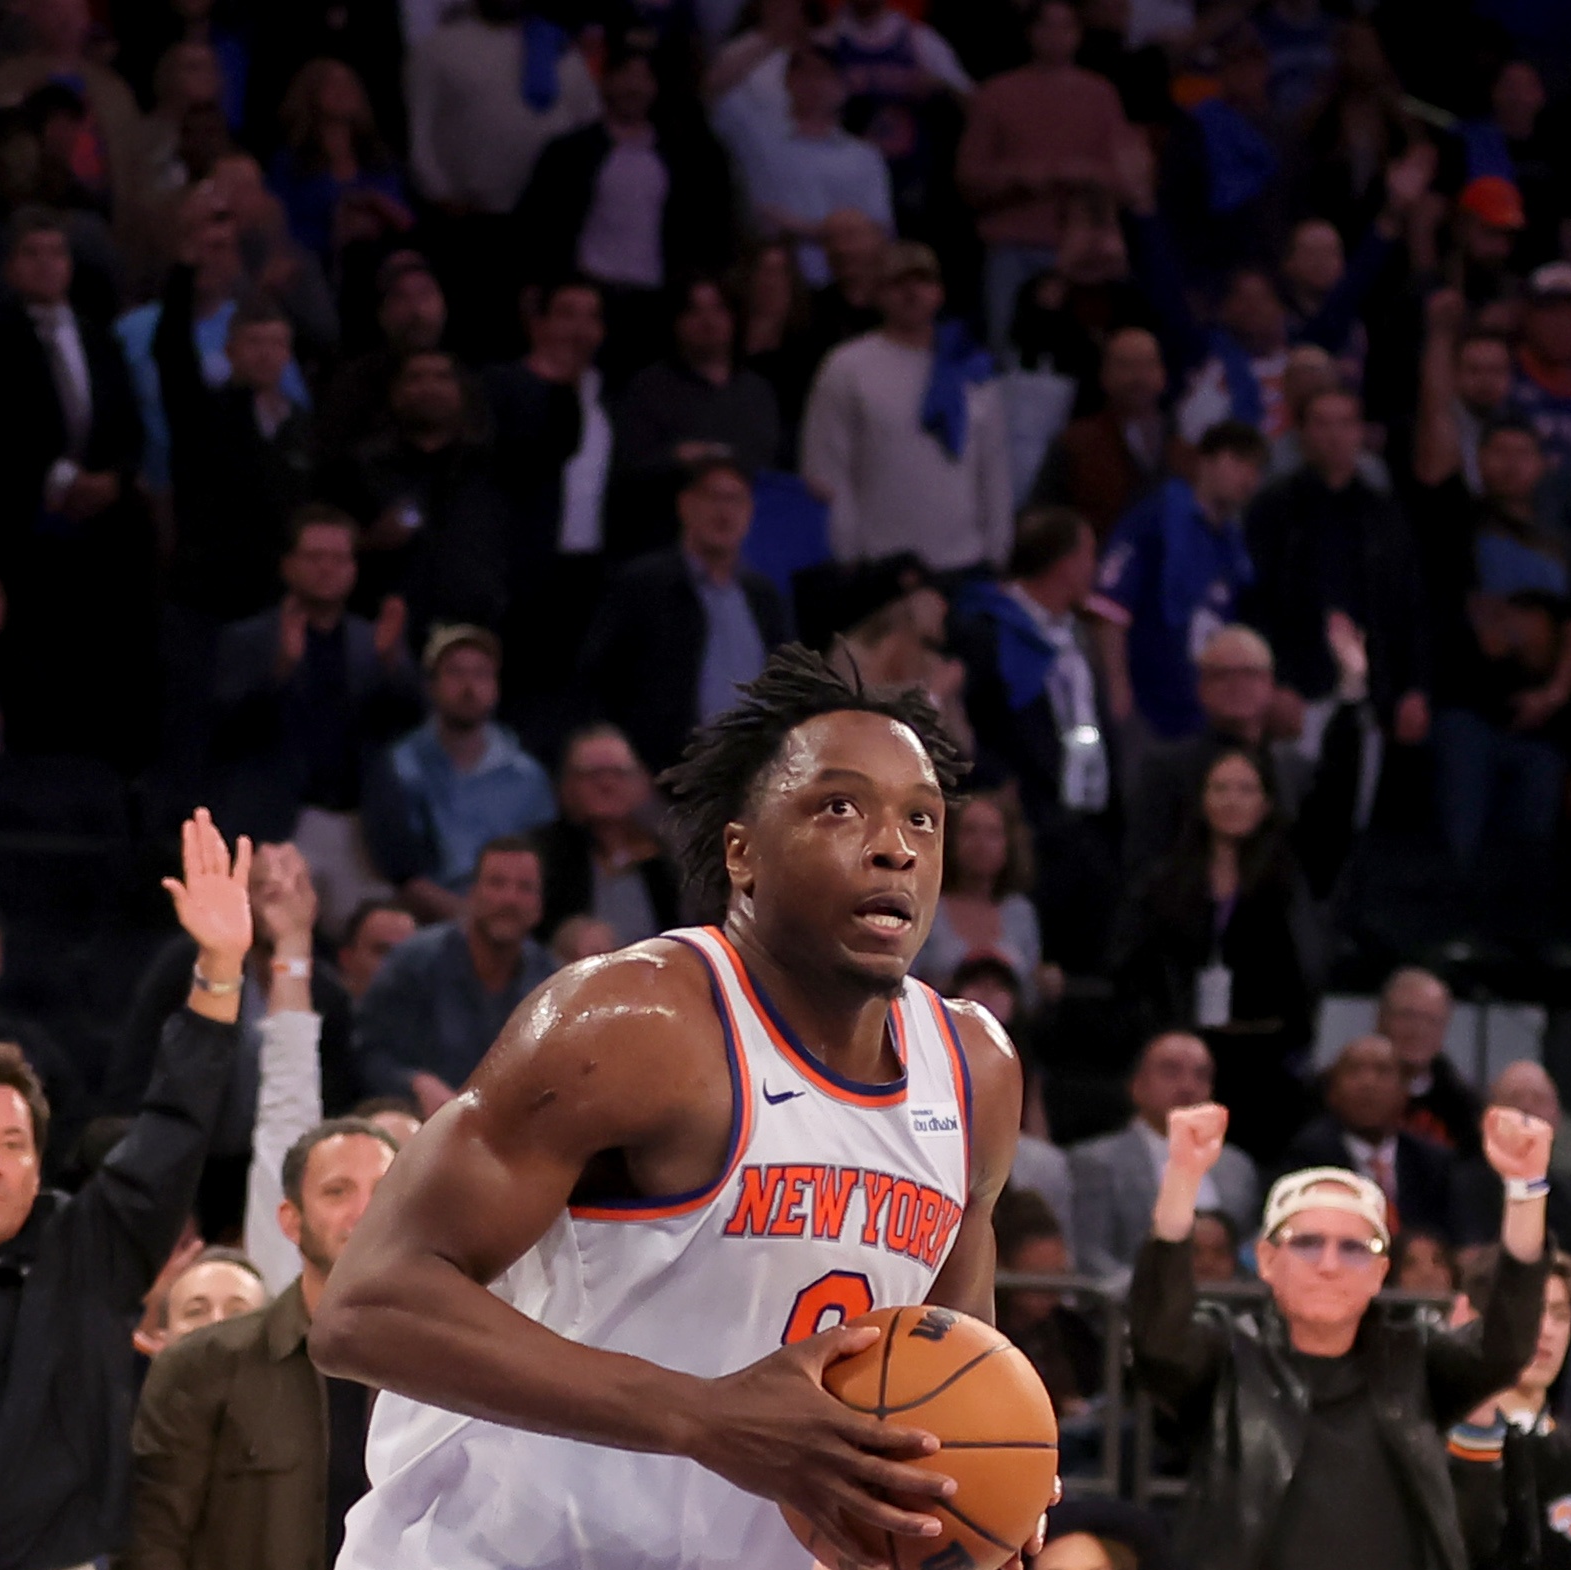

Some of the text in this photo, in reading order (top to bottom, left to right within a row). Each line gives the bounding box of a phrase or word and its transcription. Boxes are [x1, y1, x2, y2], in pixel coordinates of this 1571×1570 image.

[929, 1115, 958, 1131] dhabi
[721, 1163, 963, 1271] NEW YORK
